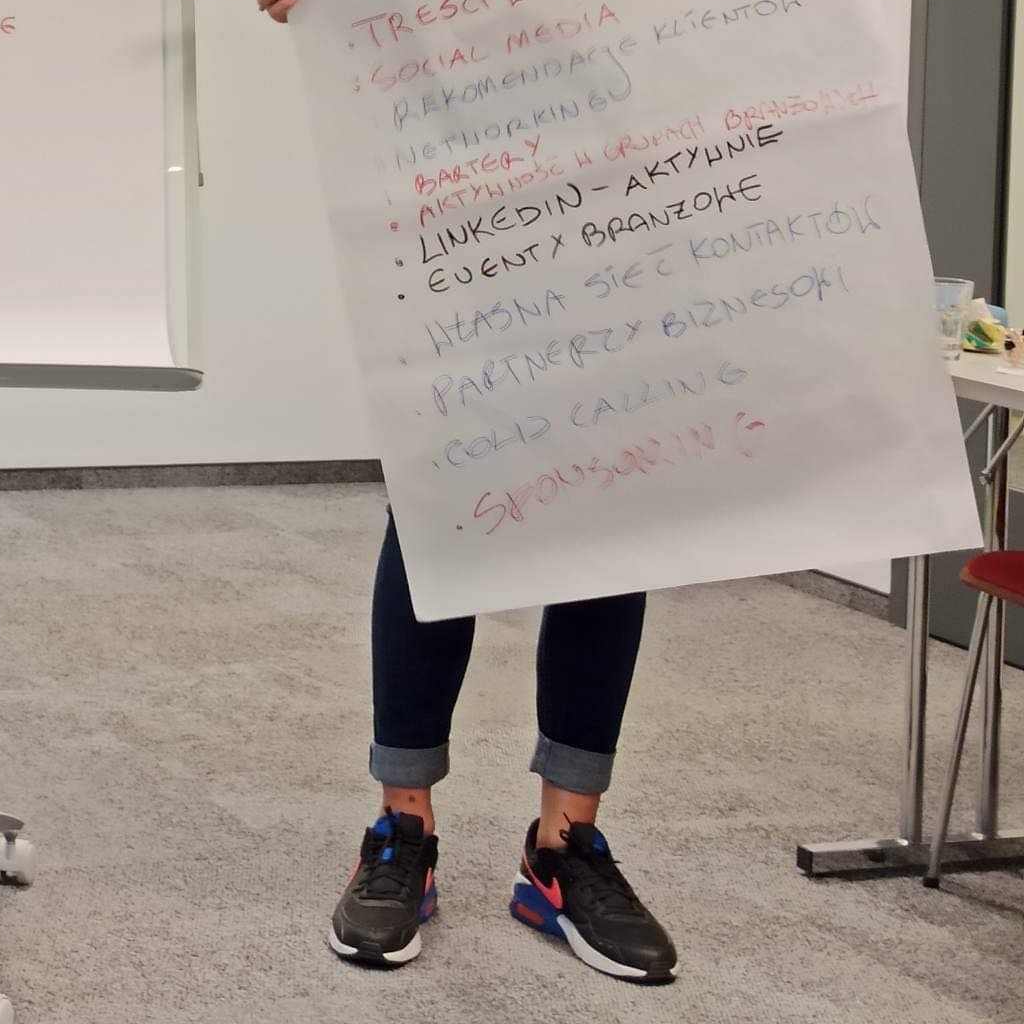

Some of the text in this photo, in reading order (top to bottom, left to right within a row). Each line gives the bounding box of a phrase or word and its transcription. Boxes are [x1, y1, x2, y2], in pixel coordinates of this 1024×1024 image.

[370, 2, 621, 93] SOCIAL MEDIA
[419, 181, 583, 265] LINKEDIN
[444, 414, 553, 468] COLD
